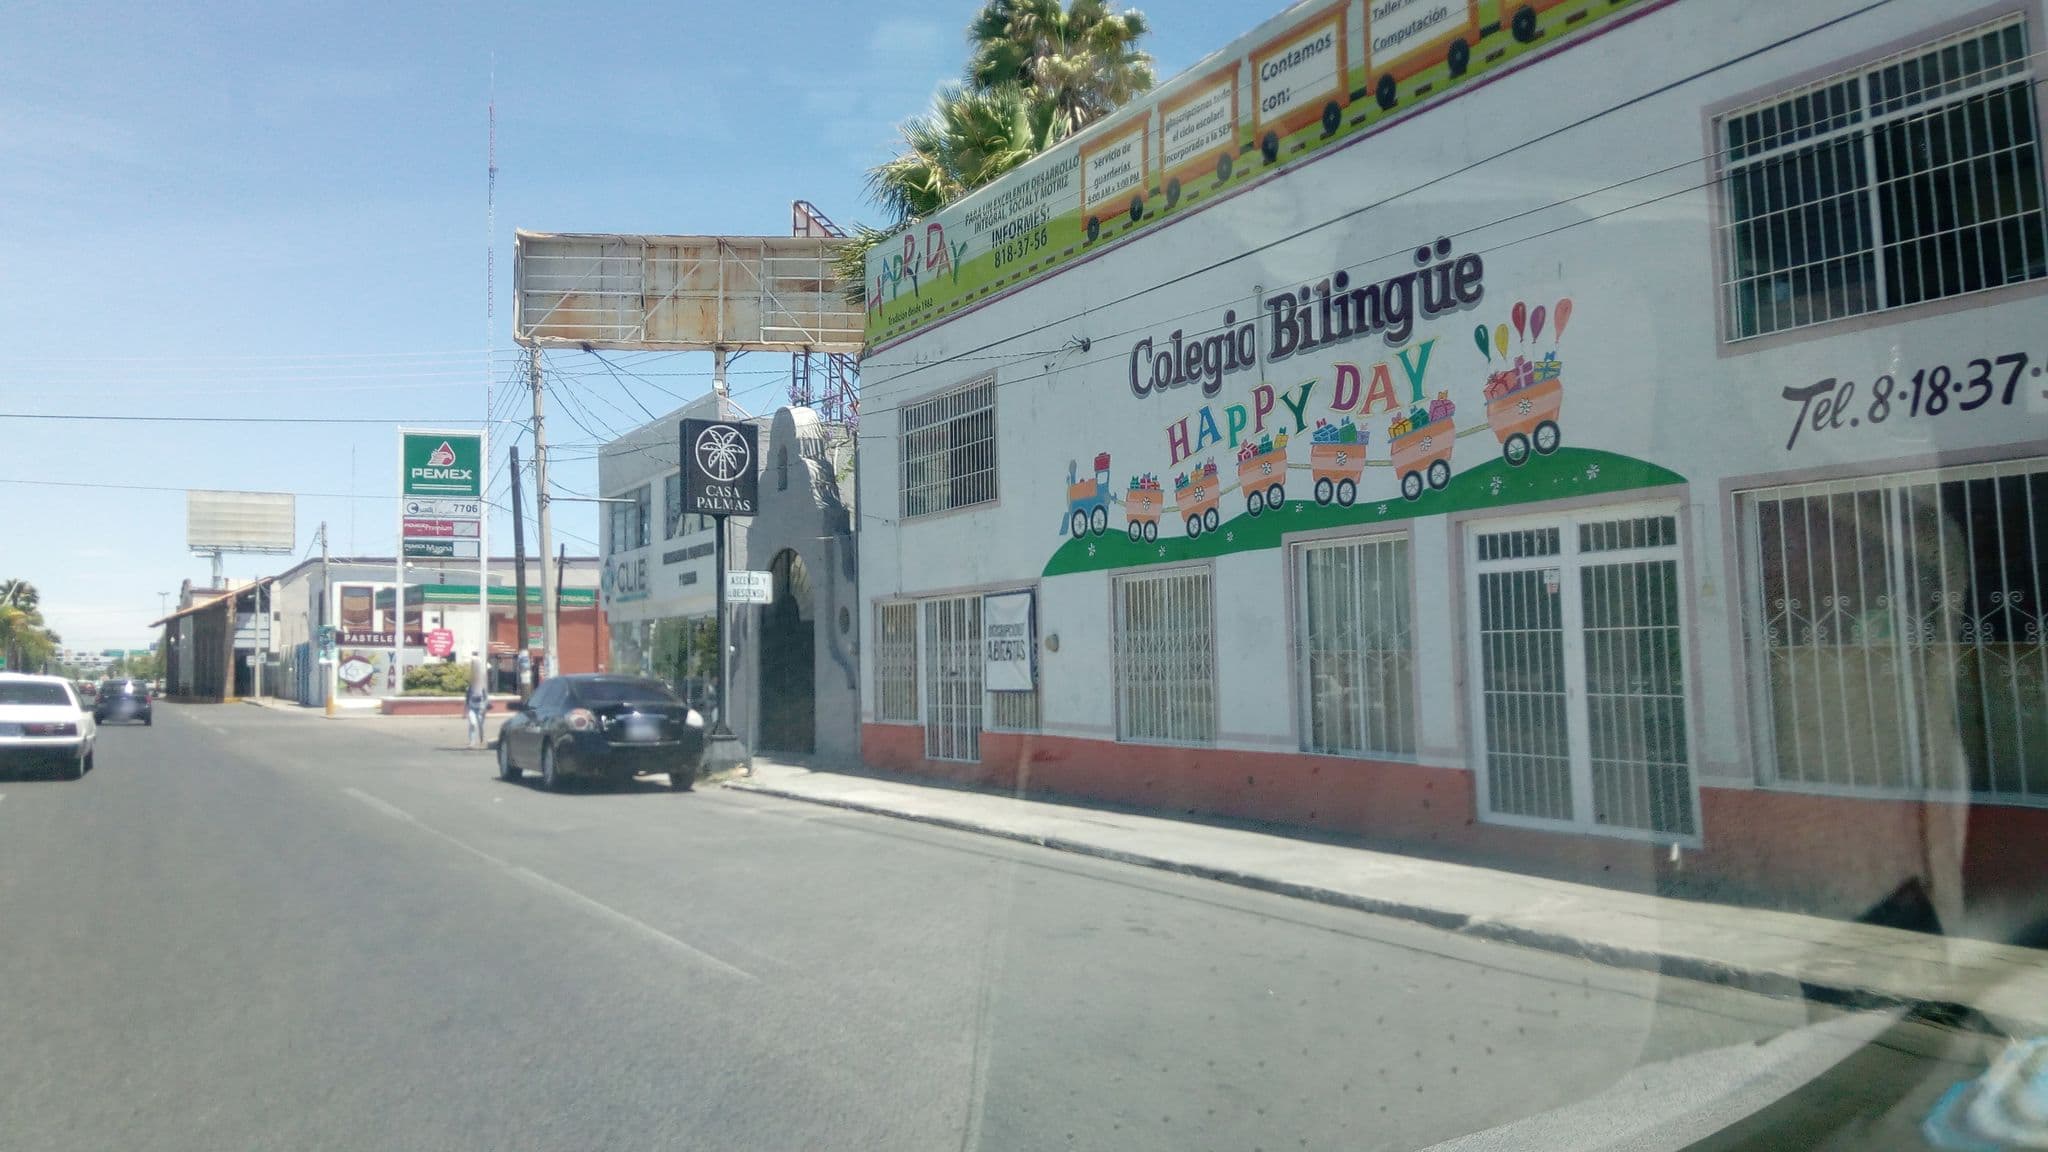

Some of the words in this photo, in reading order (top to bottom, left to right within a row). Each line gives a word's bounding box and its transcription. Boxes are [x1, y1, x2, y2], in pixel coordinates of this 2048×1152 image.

[1373, 6, 1447, 52] Computación
[1261, 31, 1332, 81] Contamos
[1262, 87, 1291, 113] con:
[1031, 155, 1080, 190] DESARROLLO
[1094, 149, 1121, 168] Servicio
[1008, 195, 1034, 216] SOCIAL
[1040, 174, 1069, 200] MOTRIZ
[992, 207, 1050, 248] INFORMES:
[994, 228, 1048, 268] 818-37-56
[867, 234, 922, 328] HAPPY
[926, 222, 968, 287] DAY
[1129, 309, 1257, 401] Colegio
[1264, 236, 1485, 348] Bilingüe
[1166, 376, 1321, 468] HAPPY
[1328, 336, 1441, 417] DAY
[1782, 377, 1860, 450] Tel.
[411, 468, 473, 480] PEMEX
[705, 485, 740, 498] CASA
[453, 503, 478, 513] 7706
[697, 496, 751, 511] PALMAS
[344, 634, 413, 643] PASTELEA
